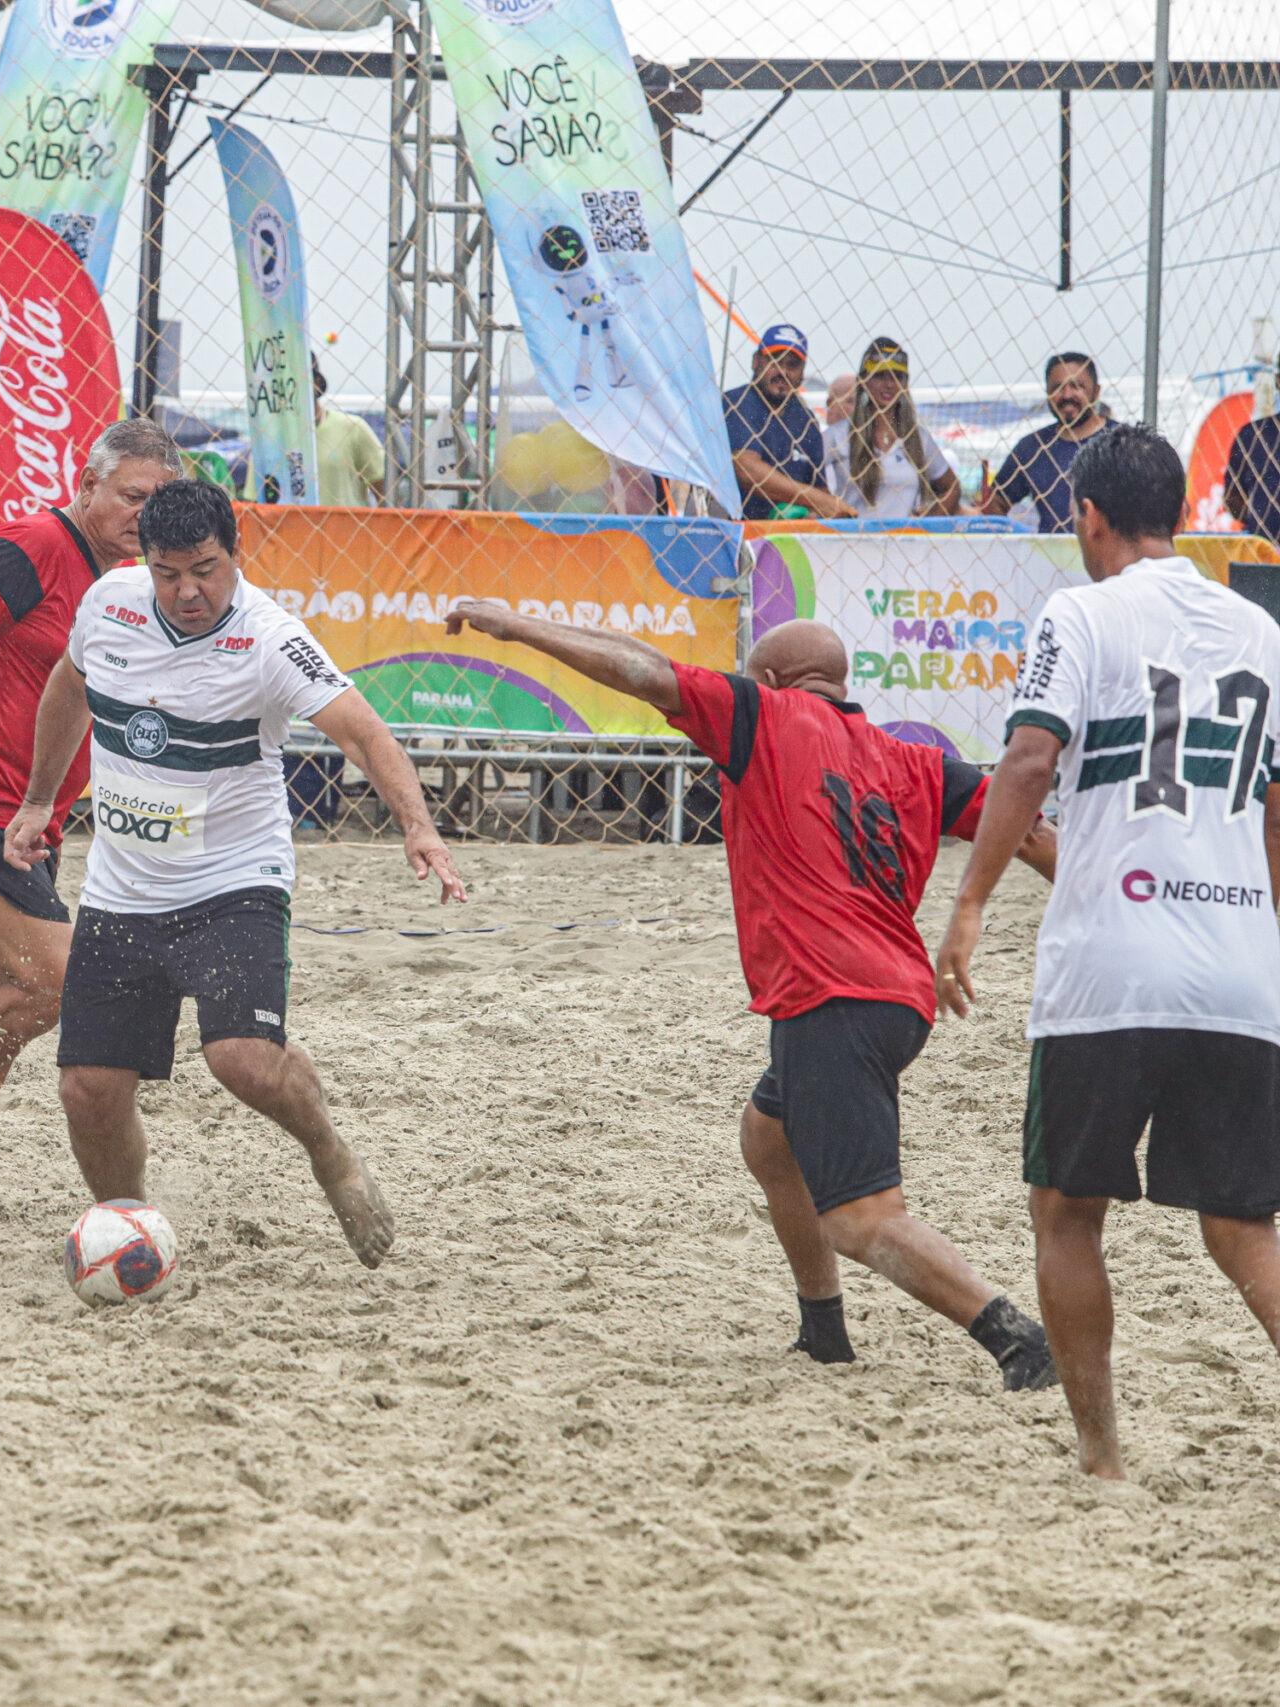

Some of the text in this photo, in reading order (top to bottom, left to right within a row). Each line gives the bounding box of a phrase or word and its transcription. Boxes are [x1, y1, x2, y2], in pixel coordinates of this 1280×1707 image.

[486, 54, 578, 112] VOCÊ
[492, 111, 602, 166] SABIA?
[865, 576, 998, 619] VERÃO
[116, 607, 148, 626] RDP
[225, 636, 255, 650] RDP
[893, 619, 1026, 651] MAIOR
[104, 651, 128, 668] 1909
[279, 640, 322, 683] TORK
[290, 636, 325, 667] PRO
[135, 727, 158, 742] CFC
[1127, 657, 1270, 826] 17
[98, 785, 175, 815] consórcio
[1162, 879, 1264, 909] NEODENT
